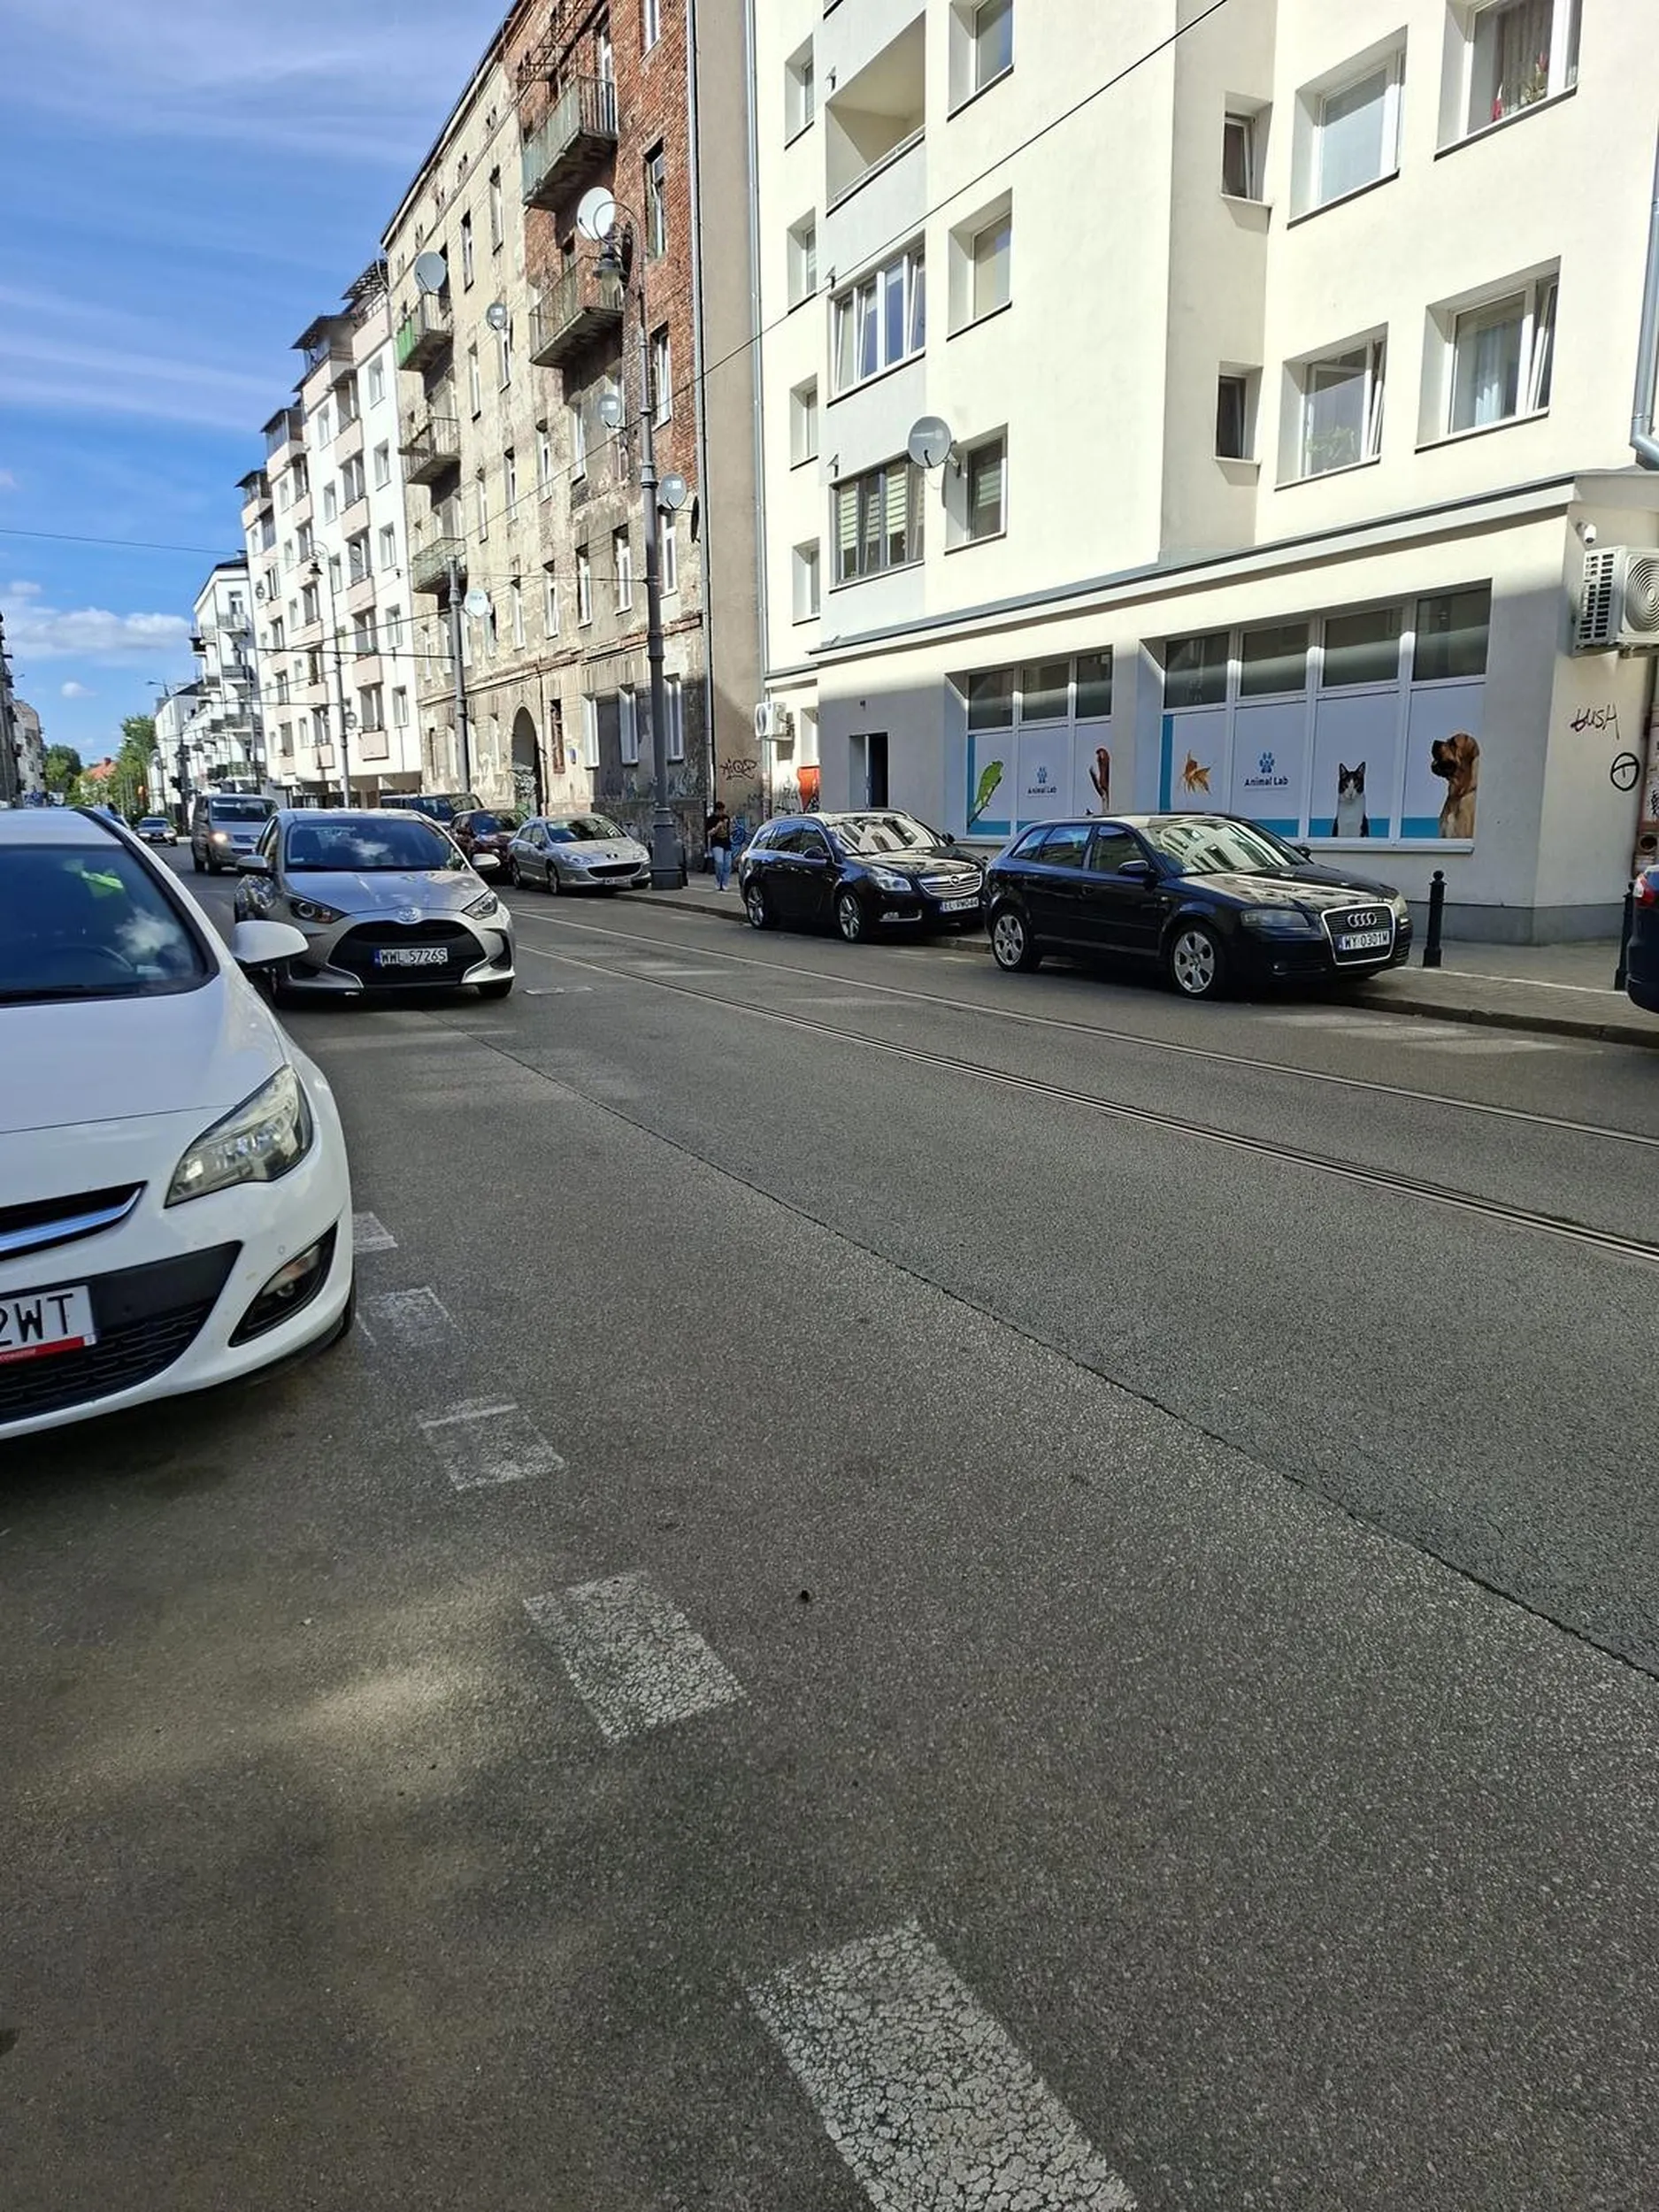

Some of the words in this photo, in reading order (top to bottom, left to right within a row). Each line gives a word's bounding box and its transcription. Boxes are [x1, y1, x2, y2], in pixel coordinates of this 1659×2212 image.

[1244, 777, 1272, 787] Animal
[1274, 776, 1288, 786] Lab
[1344, 936, 1357, 949] WY
[380, 951, 403, 963] WWL
